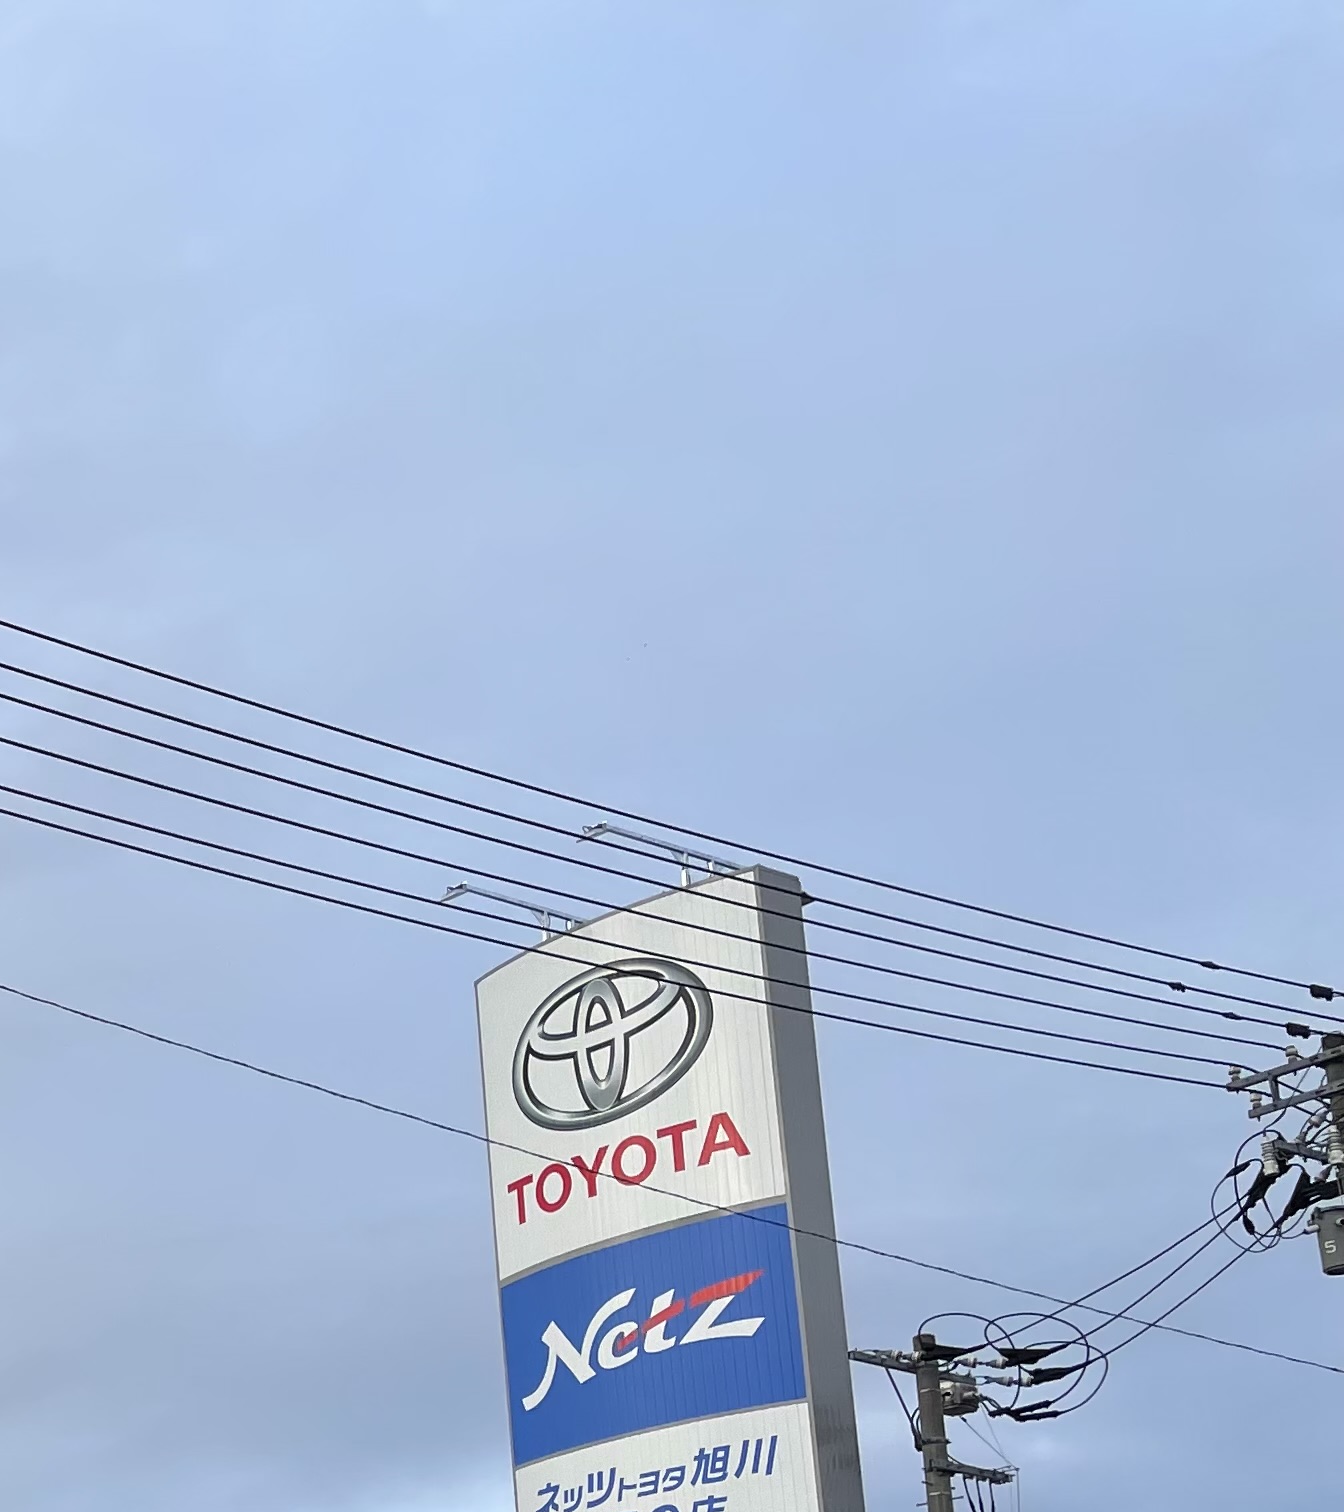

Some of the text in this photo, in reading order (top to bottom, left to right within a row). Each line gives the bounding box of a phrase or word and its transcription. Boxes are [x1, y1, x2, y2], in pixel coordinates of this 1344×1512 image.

[507, 1112, 750, 1225] TOYOTA
[1324, 1240, 1336, 1253] 5
[522, 1268, 765, 1411] Netz
